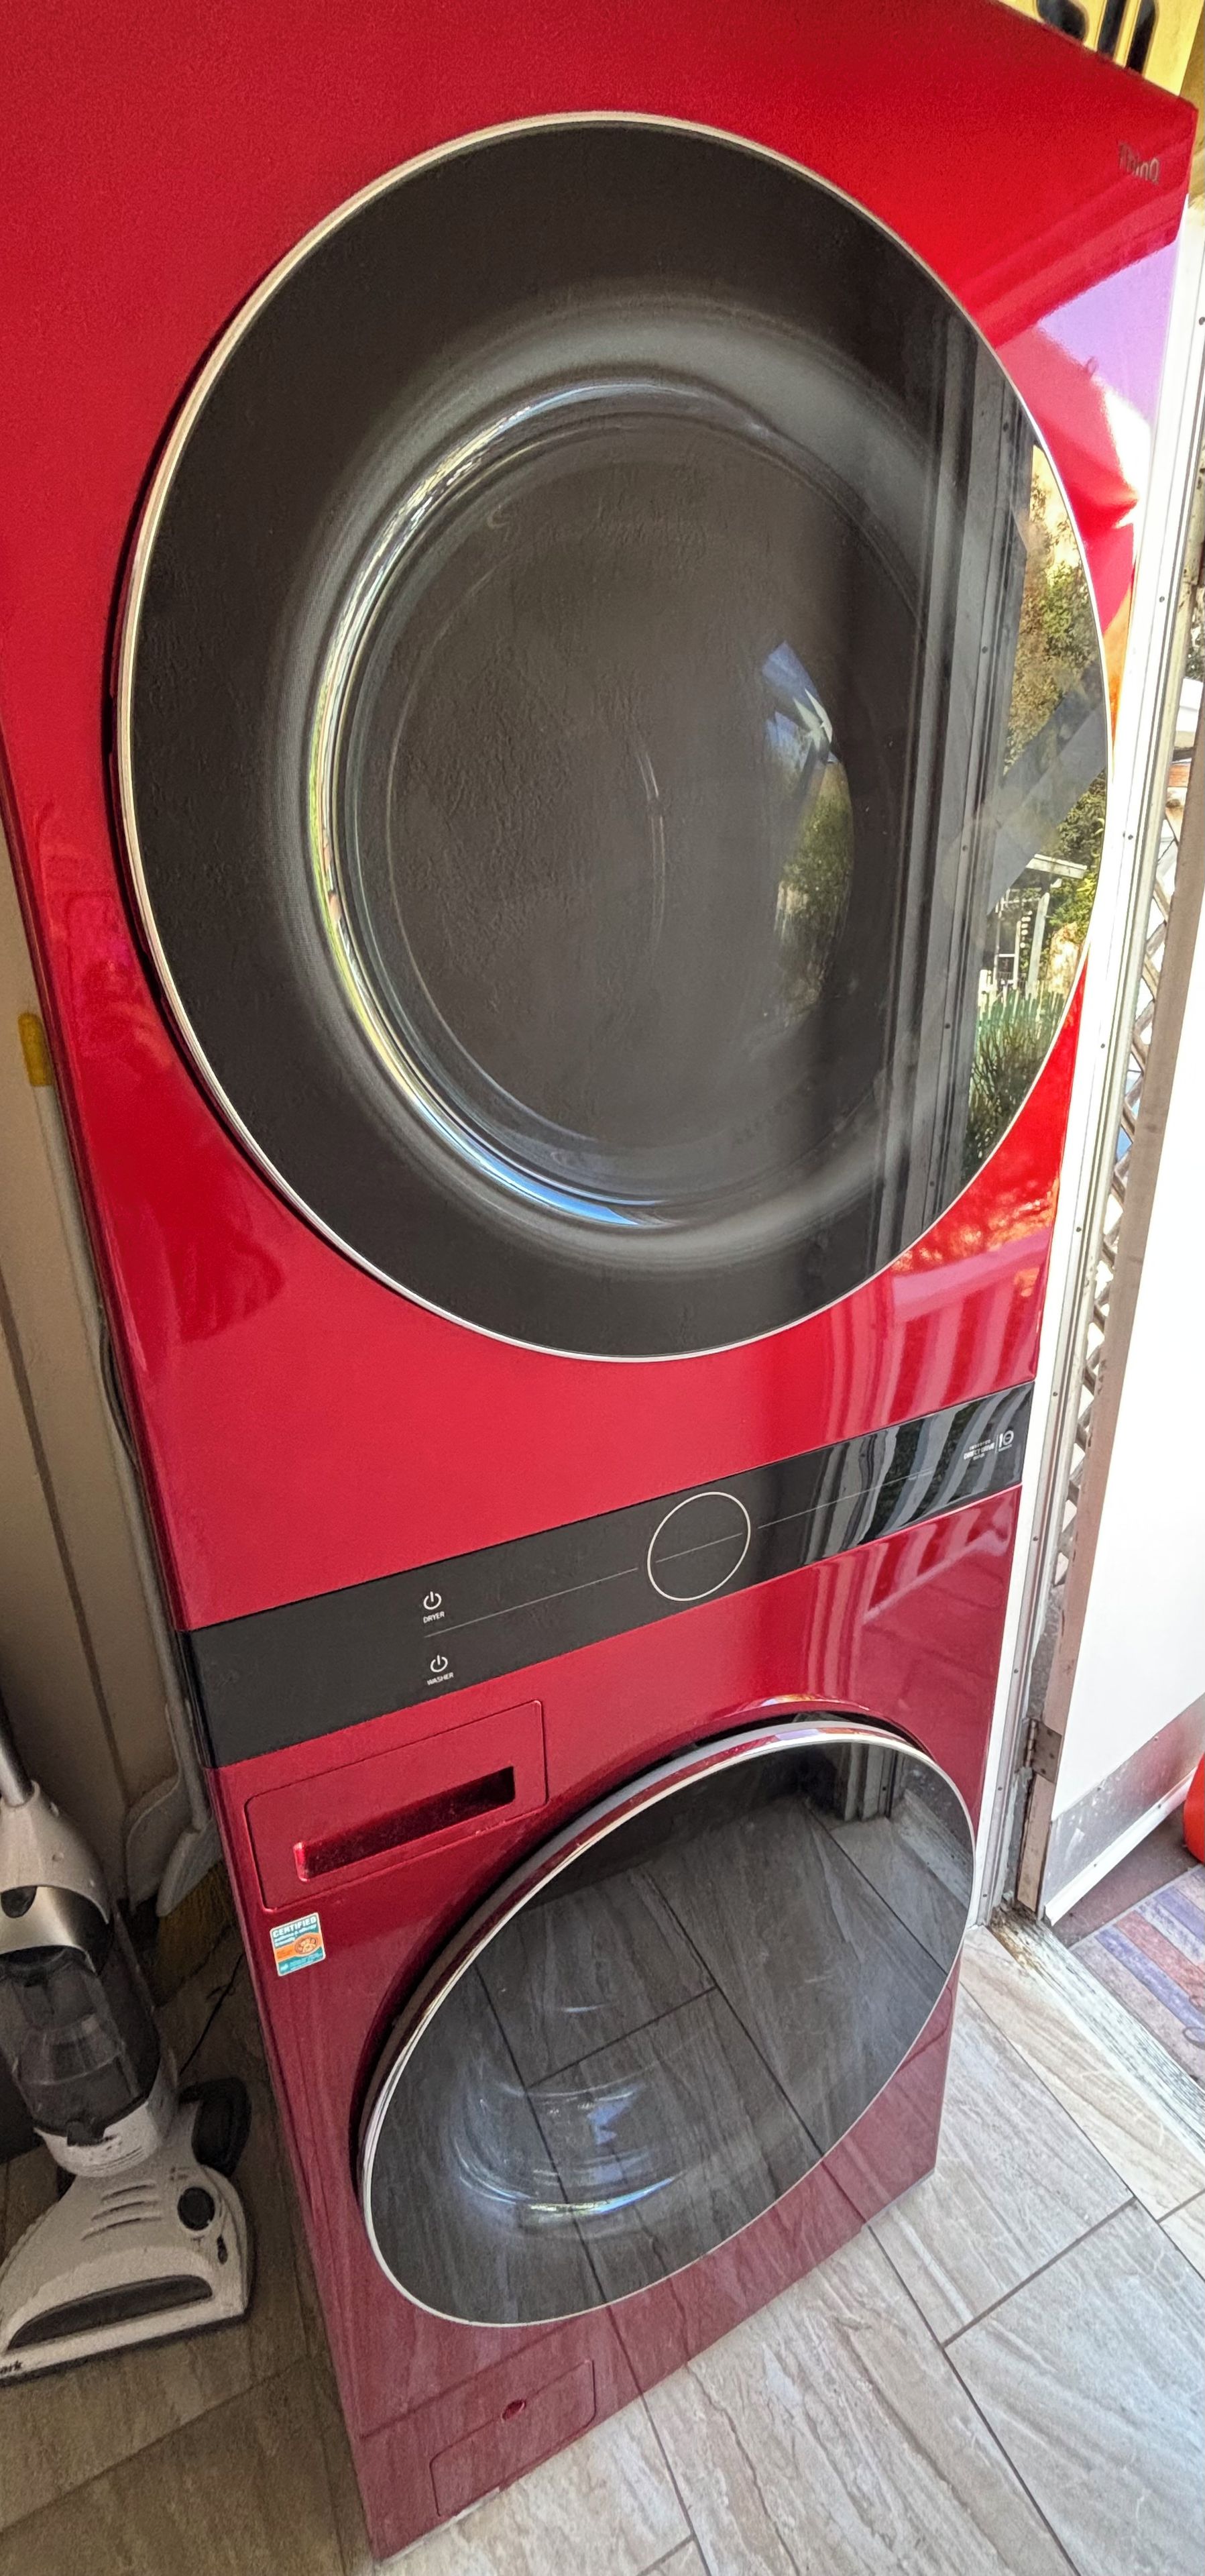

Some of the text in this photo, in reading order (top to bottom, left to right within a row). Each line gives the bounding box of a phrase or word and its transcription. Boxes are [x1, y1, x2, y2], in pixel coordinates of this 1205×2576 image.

[423, 1611, 445, 1623] DRYER
[427, 1672, 454, 1686] WASHER
[273, 1916, 317, 1938] CERTIFIED
